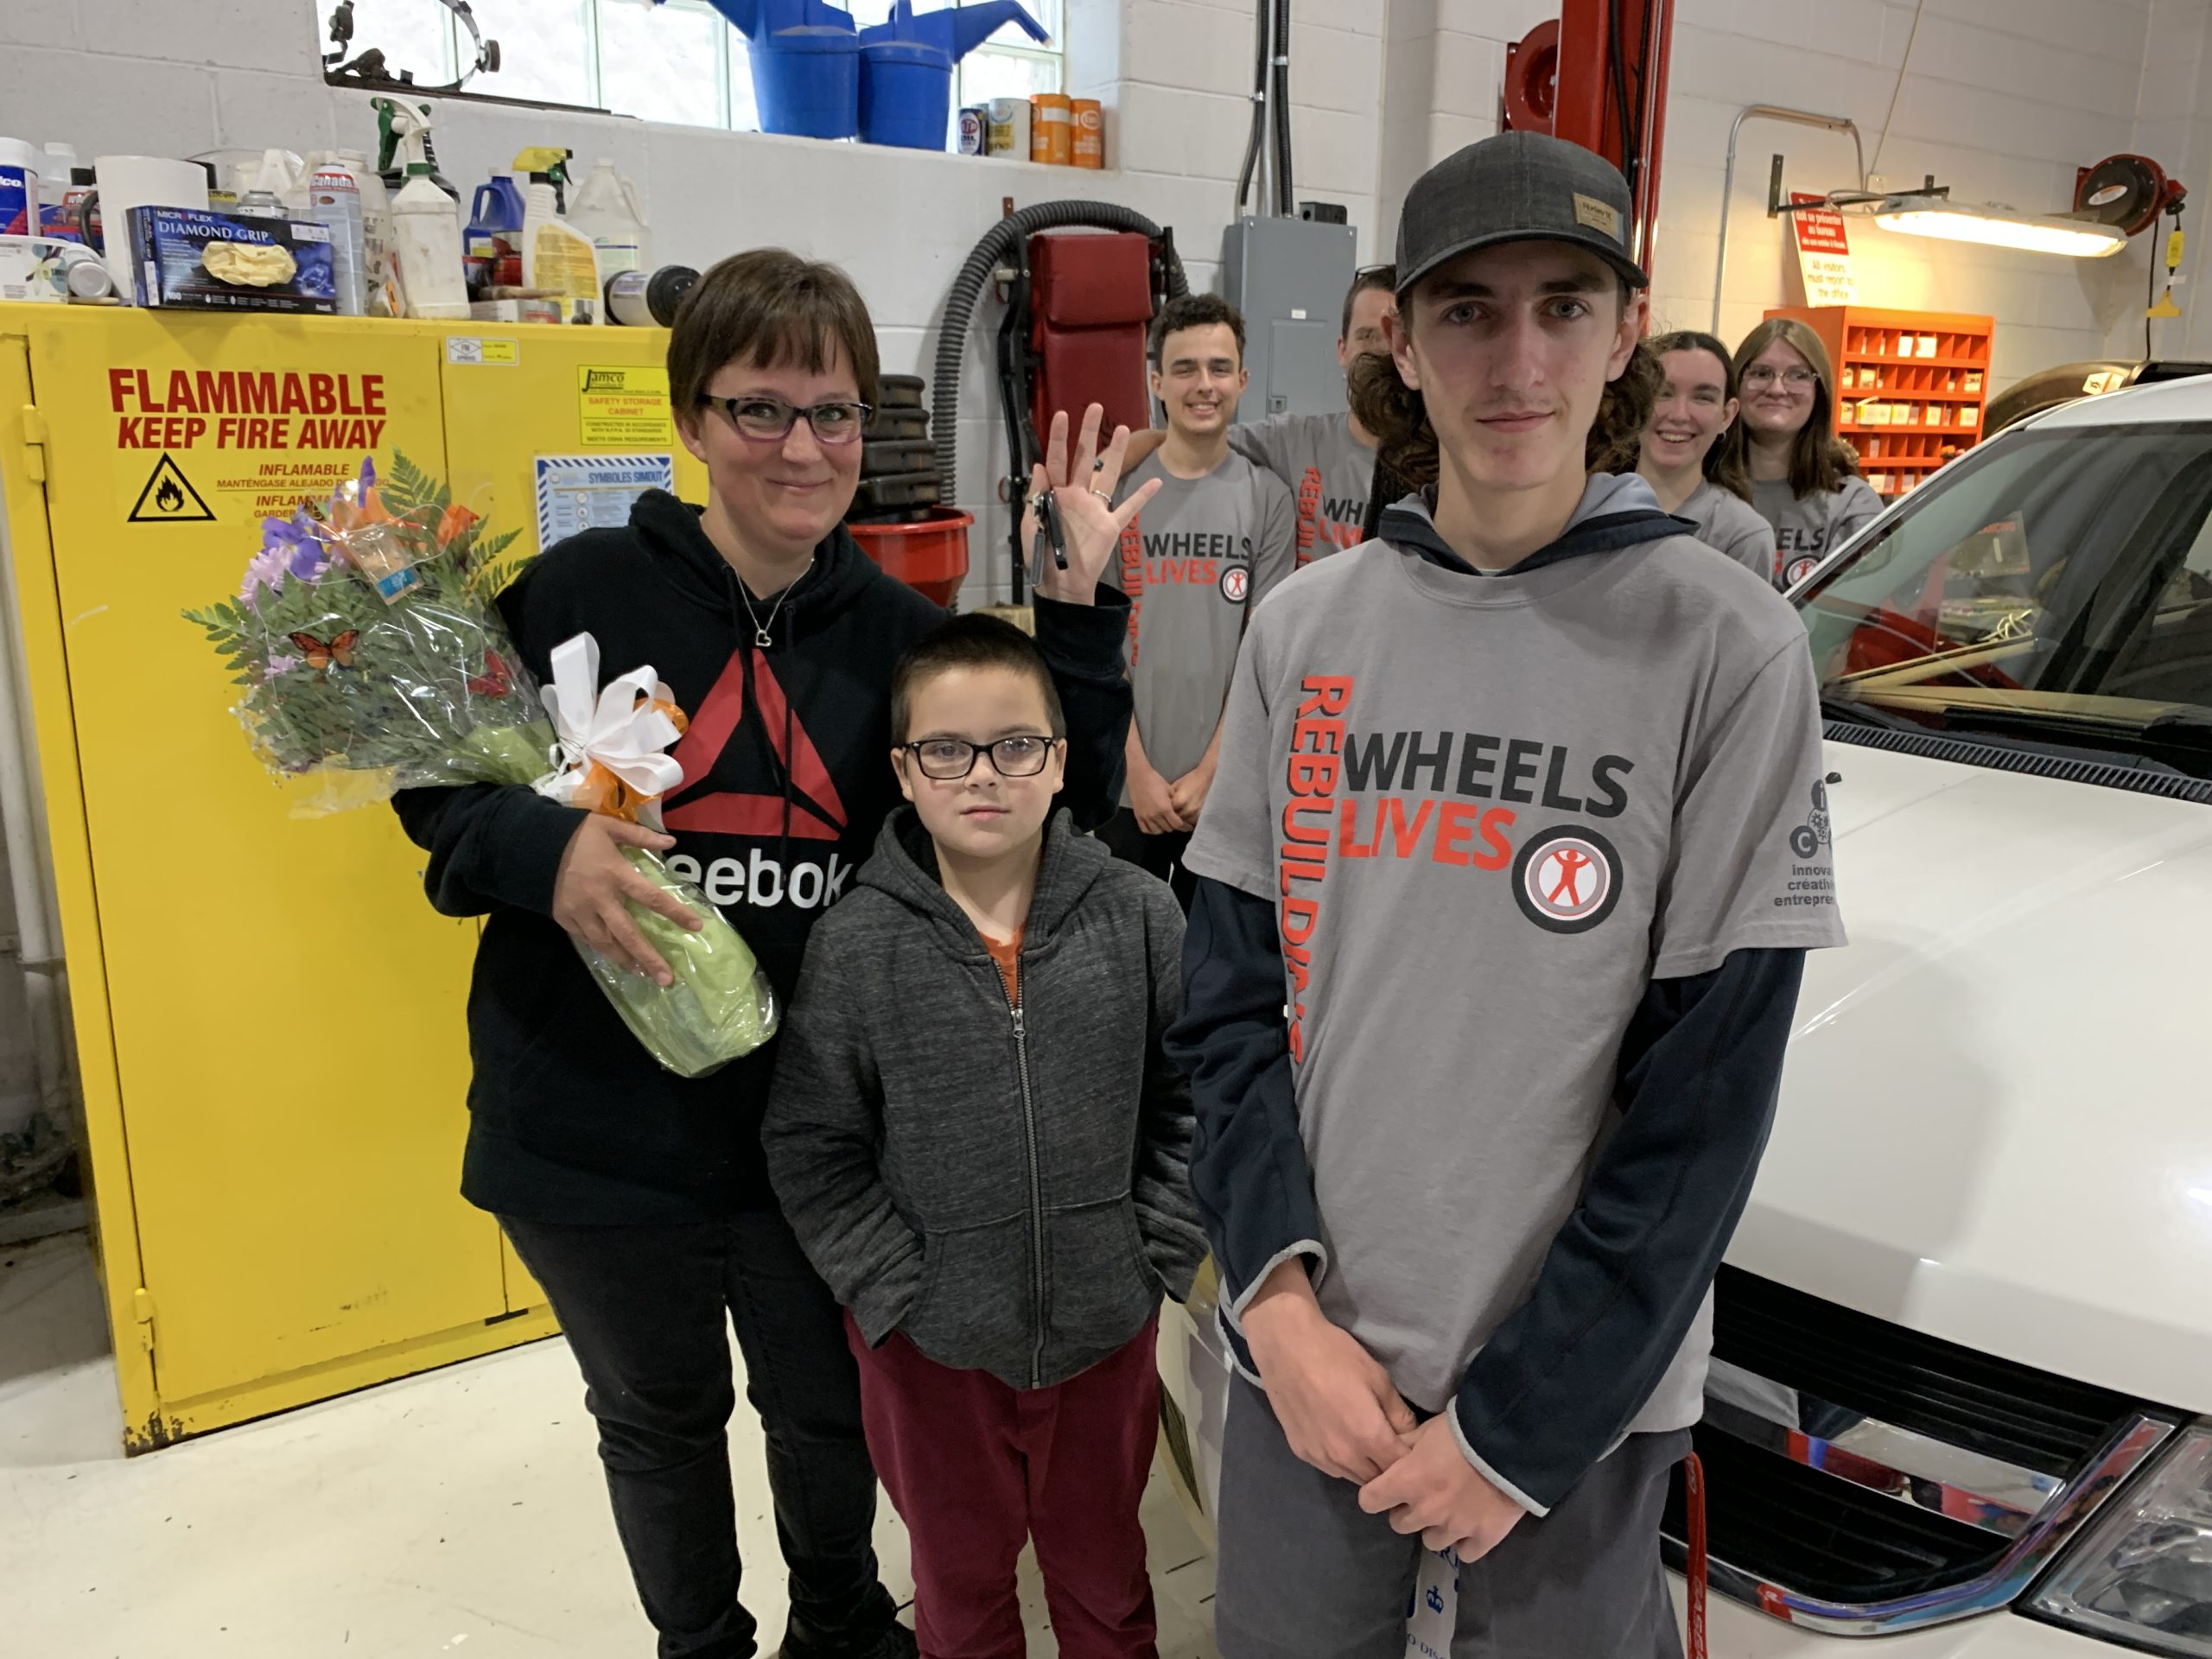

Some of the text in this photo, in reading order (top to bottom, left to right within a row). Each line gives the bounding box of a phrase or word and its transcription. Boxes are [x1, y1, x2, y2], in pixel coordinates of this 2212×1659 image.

[158, 220, 269, 243] DIAMOND GRIP
[108, 368, 387, 416] FLAMMABLE
[582, 369, 625, 392] Jamco
[607, 407, 644, 416] CABINET
[622, 397, 663, 406] STORAGE
[118, 416, 387, 449] KEEP FIRE AWAY
[258, 463, 350, 476] INFLAMABLE
[588, 472, 632, 485] SYMBOLES
[217, 477, 288, 488] MANTÉNGASE
[289, 478, 334, 487] ALEJADO
[256, 494, 334, 507] INFLAMMA
[1142, 532, 1252, 561] WHEELS
[1145, 559, 1218, 586] LIVES
[1344, 731, 1636, 818] WHEELS
[1338, 797, 1517, 872] LIVES
[664, 848, 854, 909] eebok
[1774, 893, 1835, 907] entrepre
